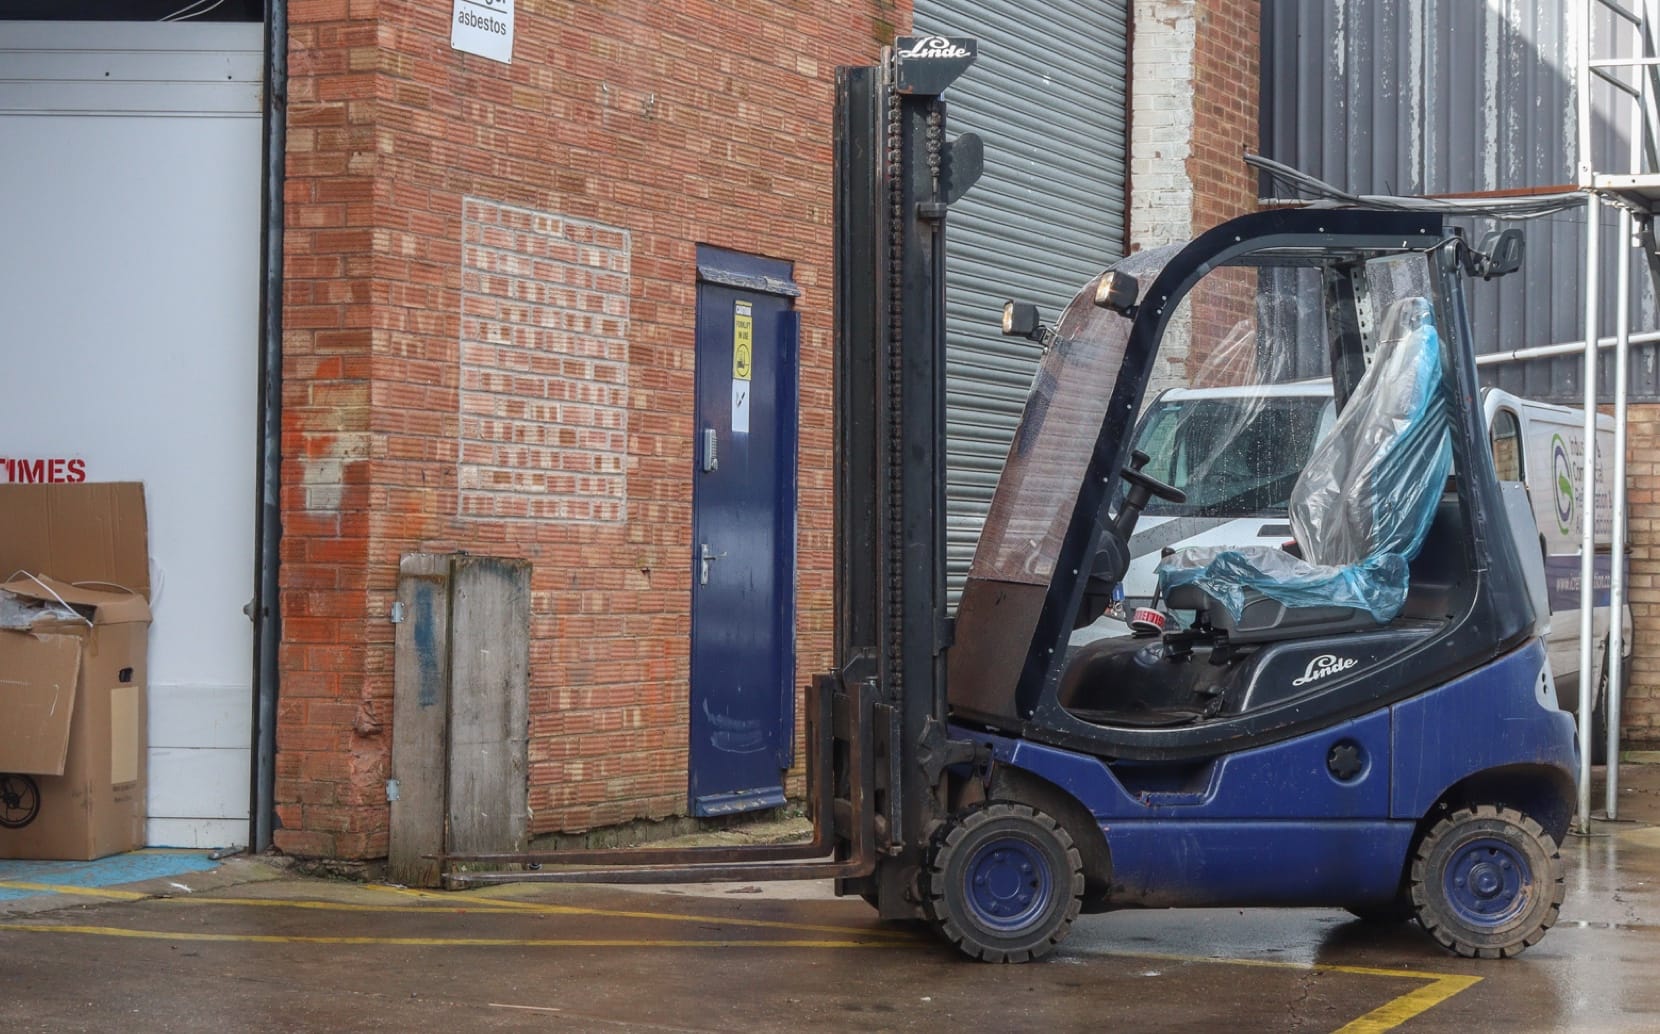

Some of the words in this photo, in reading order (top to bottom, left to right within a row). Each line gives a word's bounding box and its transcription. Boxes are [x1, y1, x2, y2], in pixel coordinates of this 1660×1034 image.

[458, 10, 507, 36] asbestos
[898, 36, 971, 58] Linde
[1292, 654, 1358, 686] Linde
